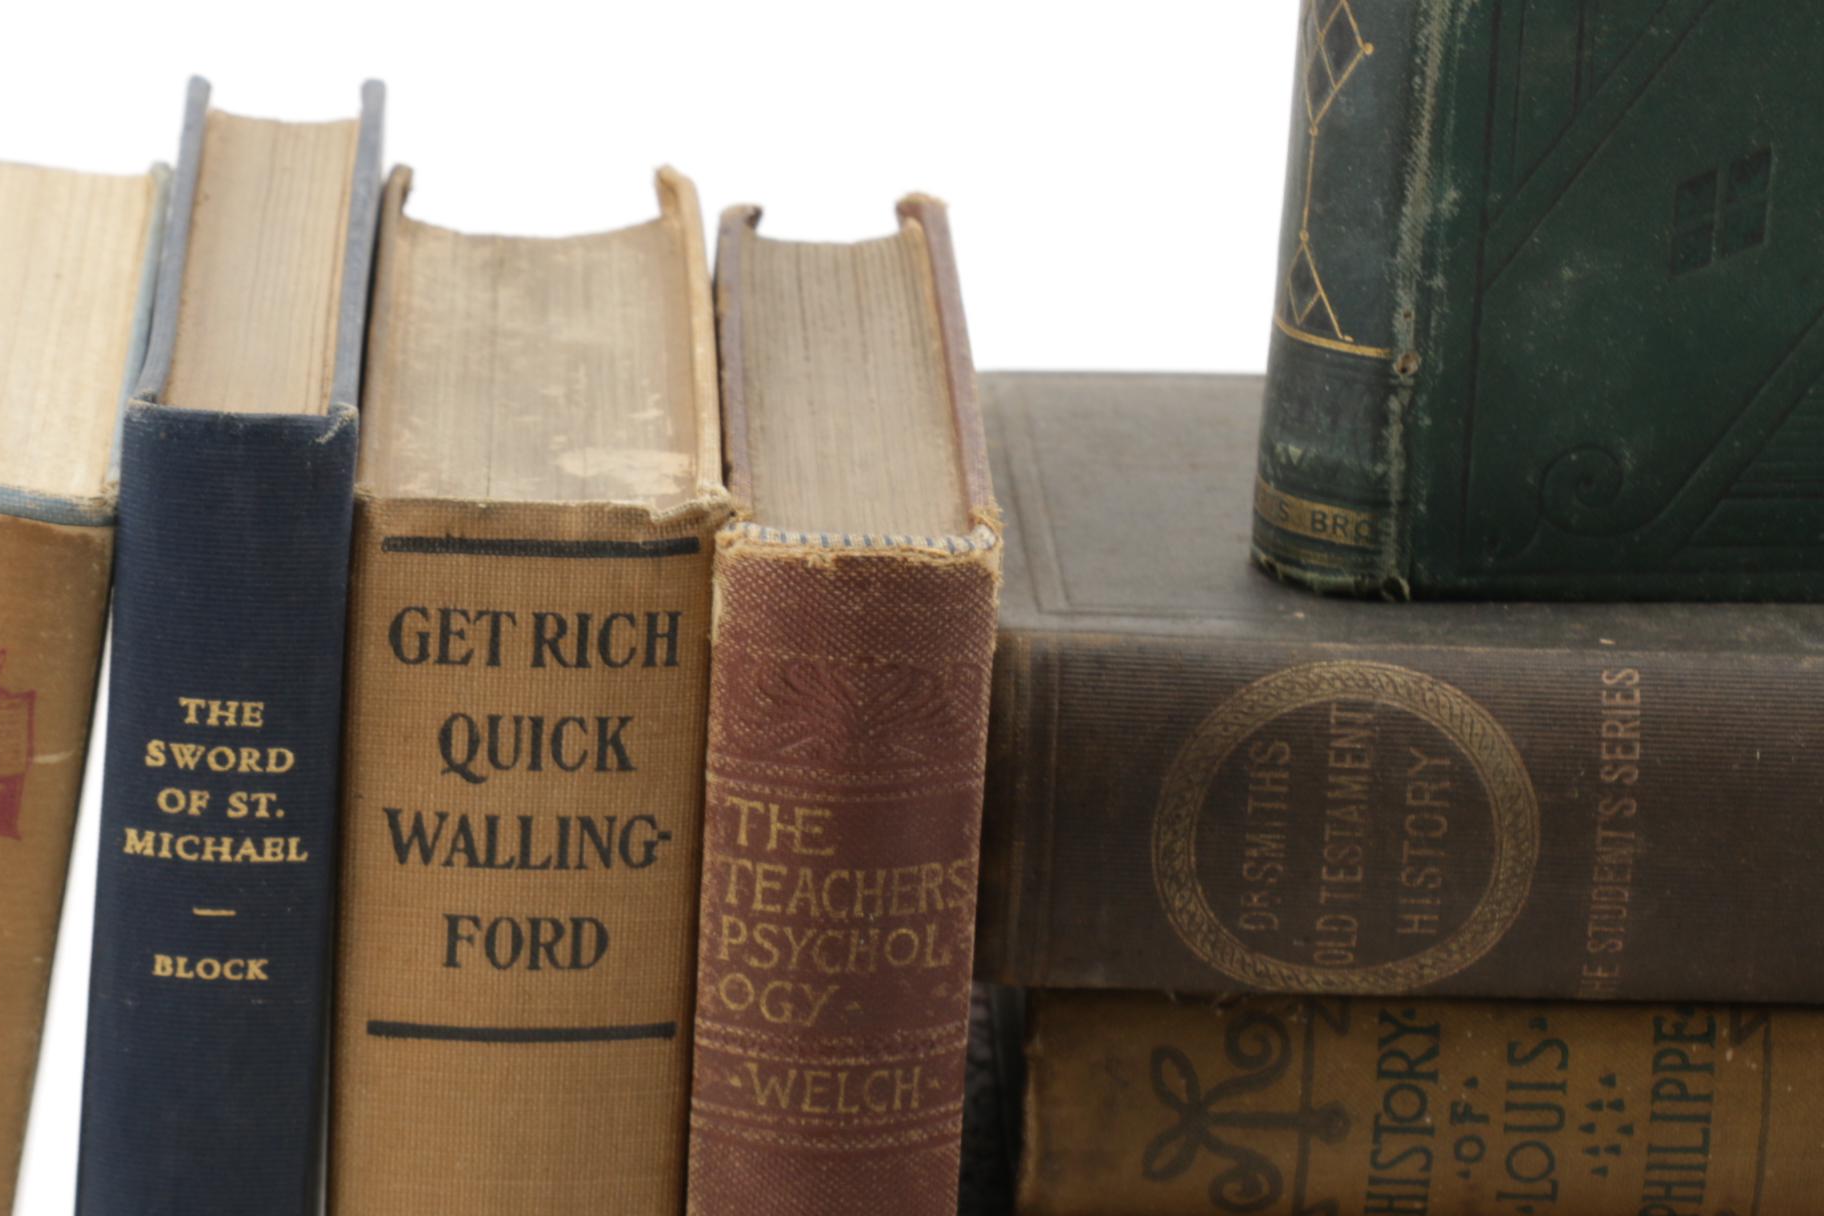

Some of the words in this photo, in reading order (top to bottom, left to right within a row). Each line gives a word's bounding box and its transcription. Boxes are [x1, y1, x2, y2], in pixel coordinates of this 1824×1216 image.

[387, 606, 517, 667] GET
[530, 610, 683, 669] RICH
[179, 696, 265, 727] THE
[1600, 666, 1641, 786] SERIES
[144, 739, 296, 773] SWORD
[437, 712, 638, 785] QUICK
[157, 787, 210, 816] OF
[227, 791, 285, 818] ST.
[725, 796, 836, 856] THE
[1321, 702, 1378, 905] TESTAMENT
[124, 827, 309, 863] MICHAEL
[382, 807, 672, 871] WALLING-
[1396, 746, 1452, 935] HISTORY
[716, 852, 977, 919] TEACHERS
[152, 954, 269, 981] BLOCK
[441, 912, 610, 971] FORD
[1314, 916, 1359, 968] OLD
[717, 972, 840, 1027] OGY
[742, 1061, 923, 1115] WELCH
[1451, 1100, 1491, 1166] OF
[1496, 1036, 1570, 1204] LOUIS
